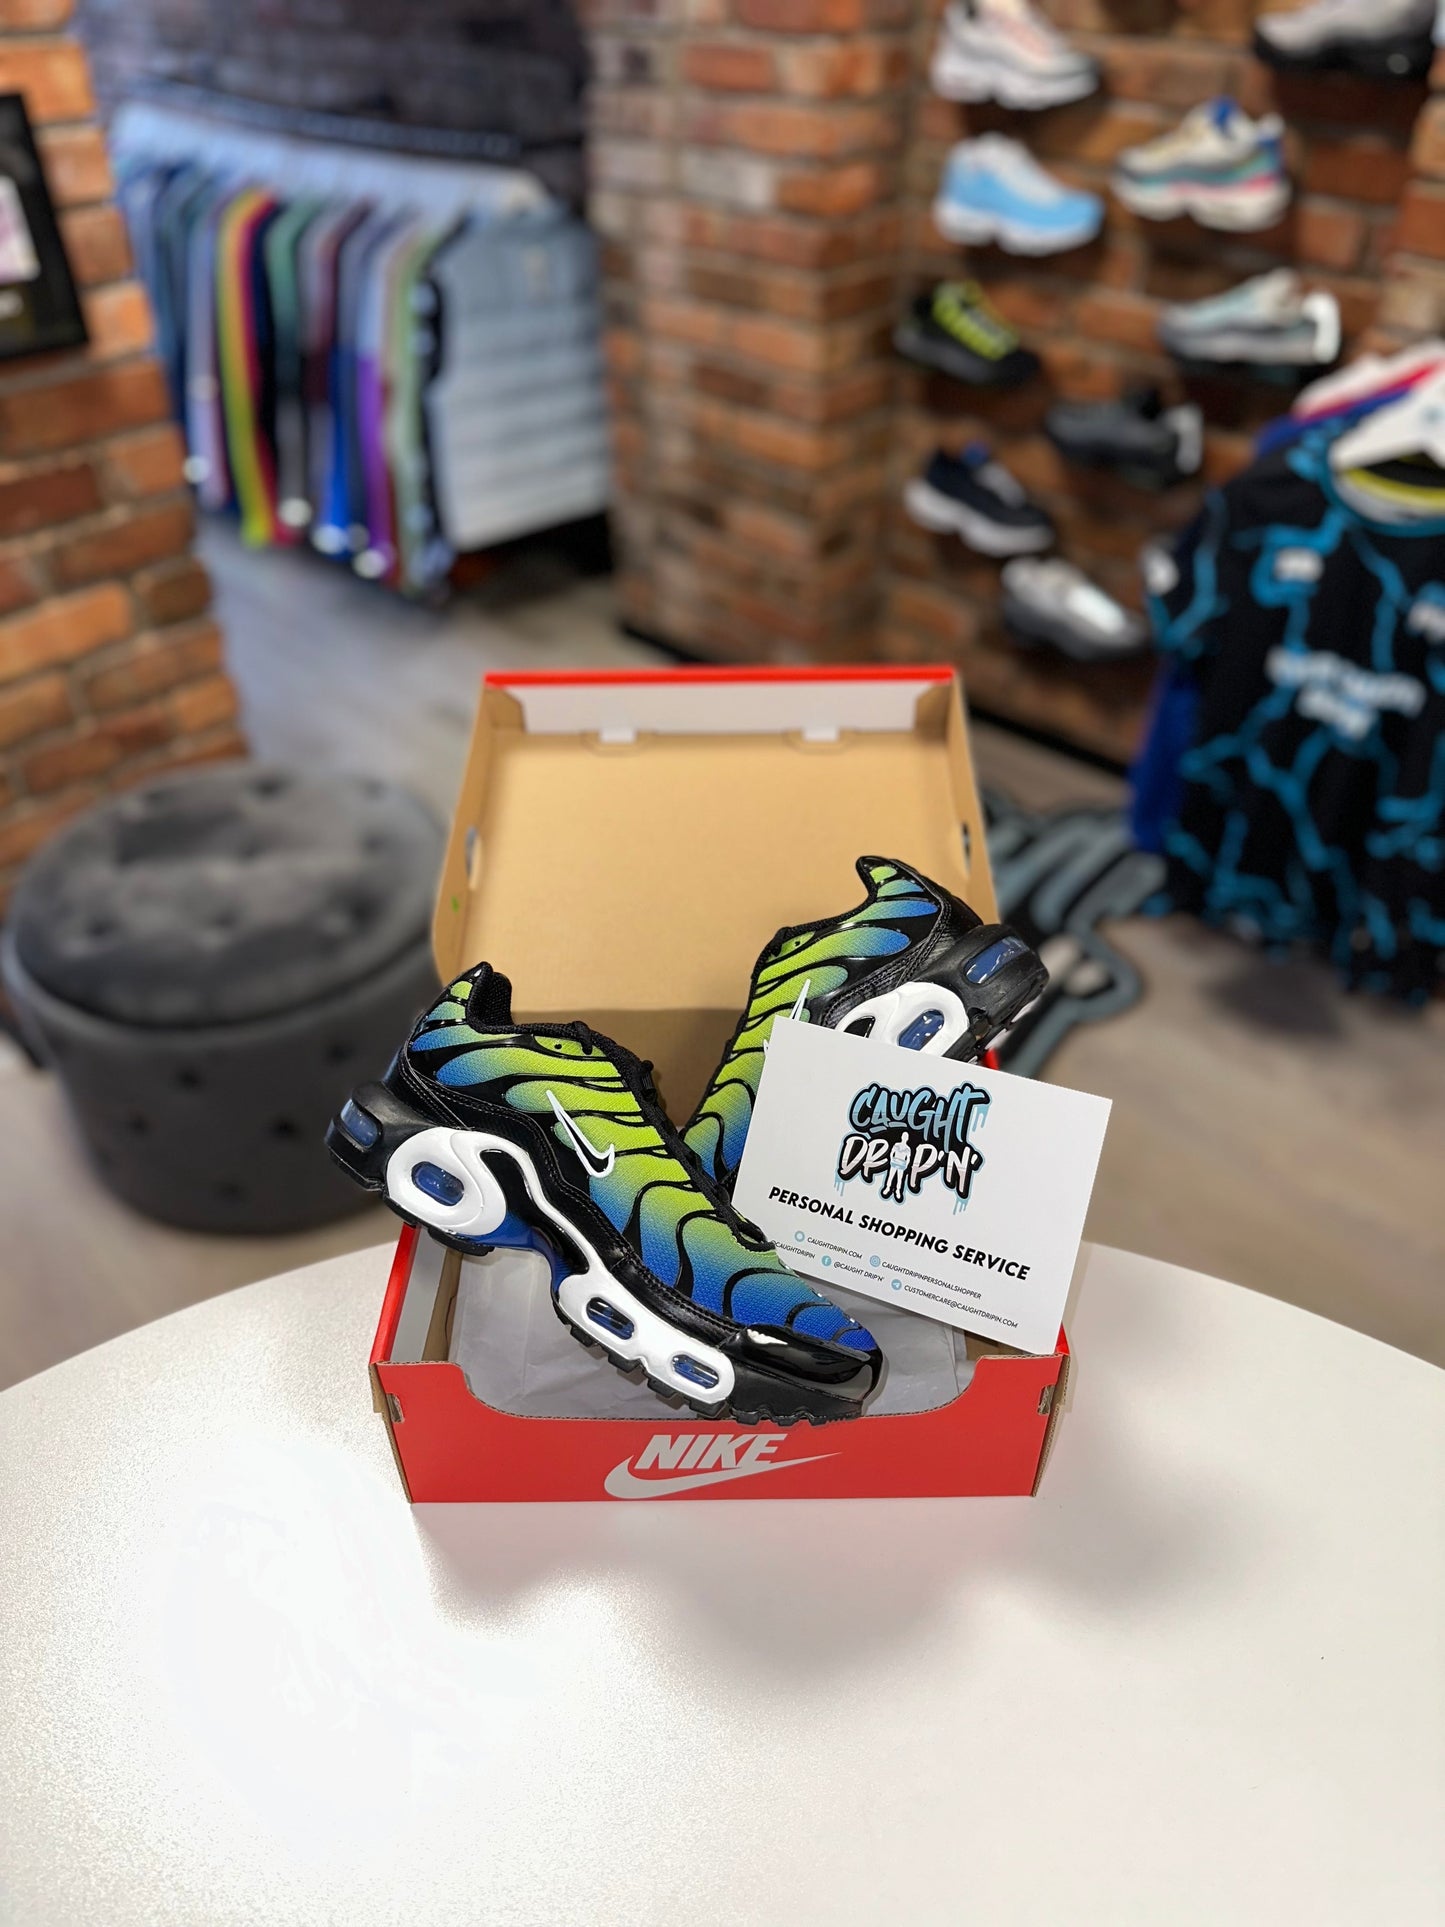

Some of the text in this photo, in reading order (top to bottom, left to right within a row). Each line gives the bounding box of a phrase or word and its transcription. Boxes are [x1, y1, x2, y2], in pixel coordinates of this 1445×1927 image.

[850, 1083, 988, 1153] CAUGHT
[768, 1186, 1031, 1281] PERSONAL SHOPPING SERVICE
[807, 1236, 863, 1260] CAUGHTDRIPIN.COM
[833, 1261, 864, 1277] @CAUGHT
[881, 1261, 982, 1300] CAUGHTDRIPINPERSONALSHOPPER
[903, 1284, 1019, 1329] CUSTOMERCARE@CAUGHTDRIPIN.COM
[634, 1433, 788, 1469] NIKE
